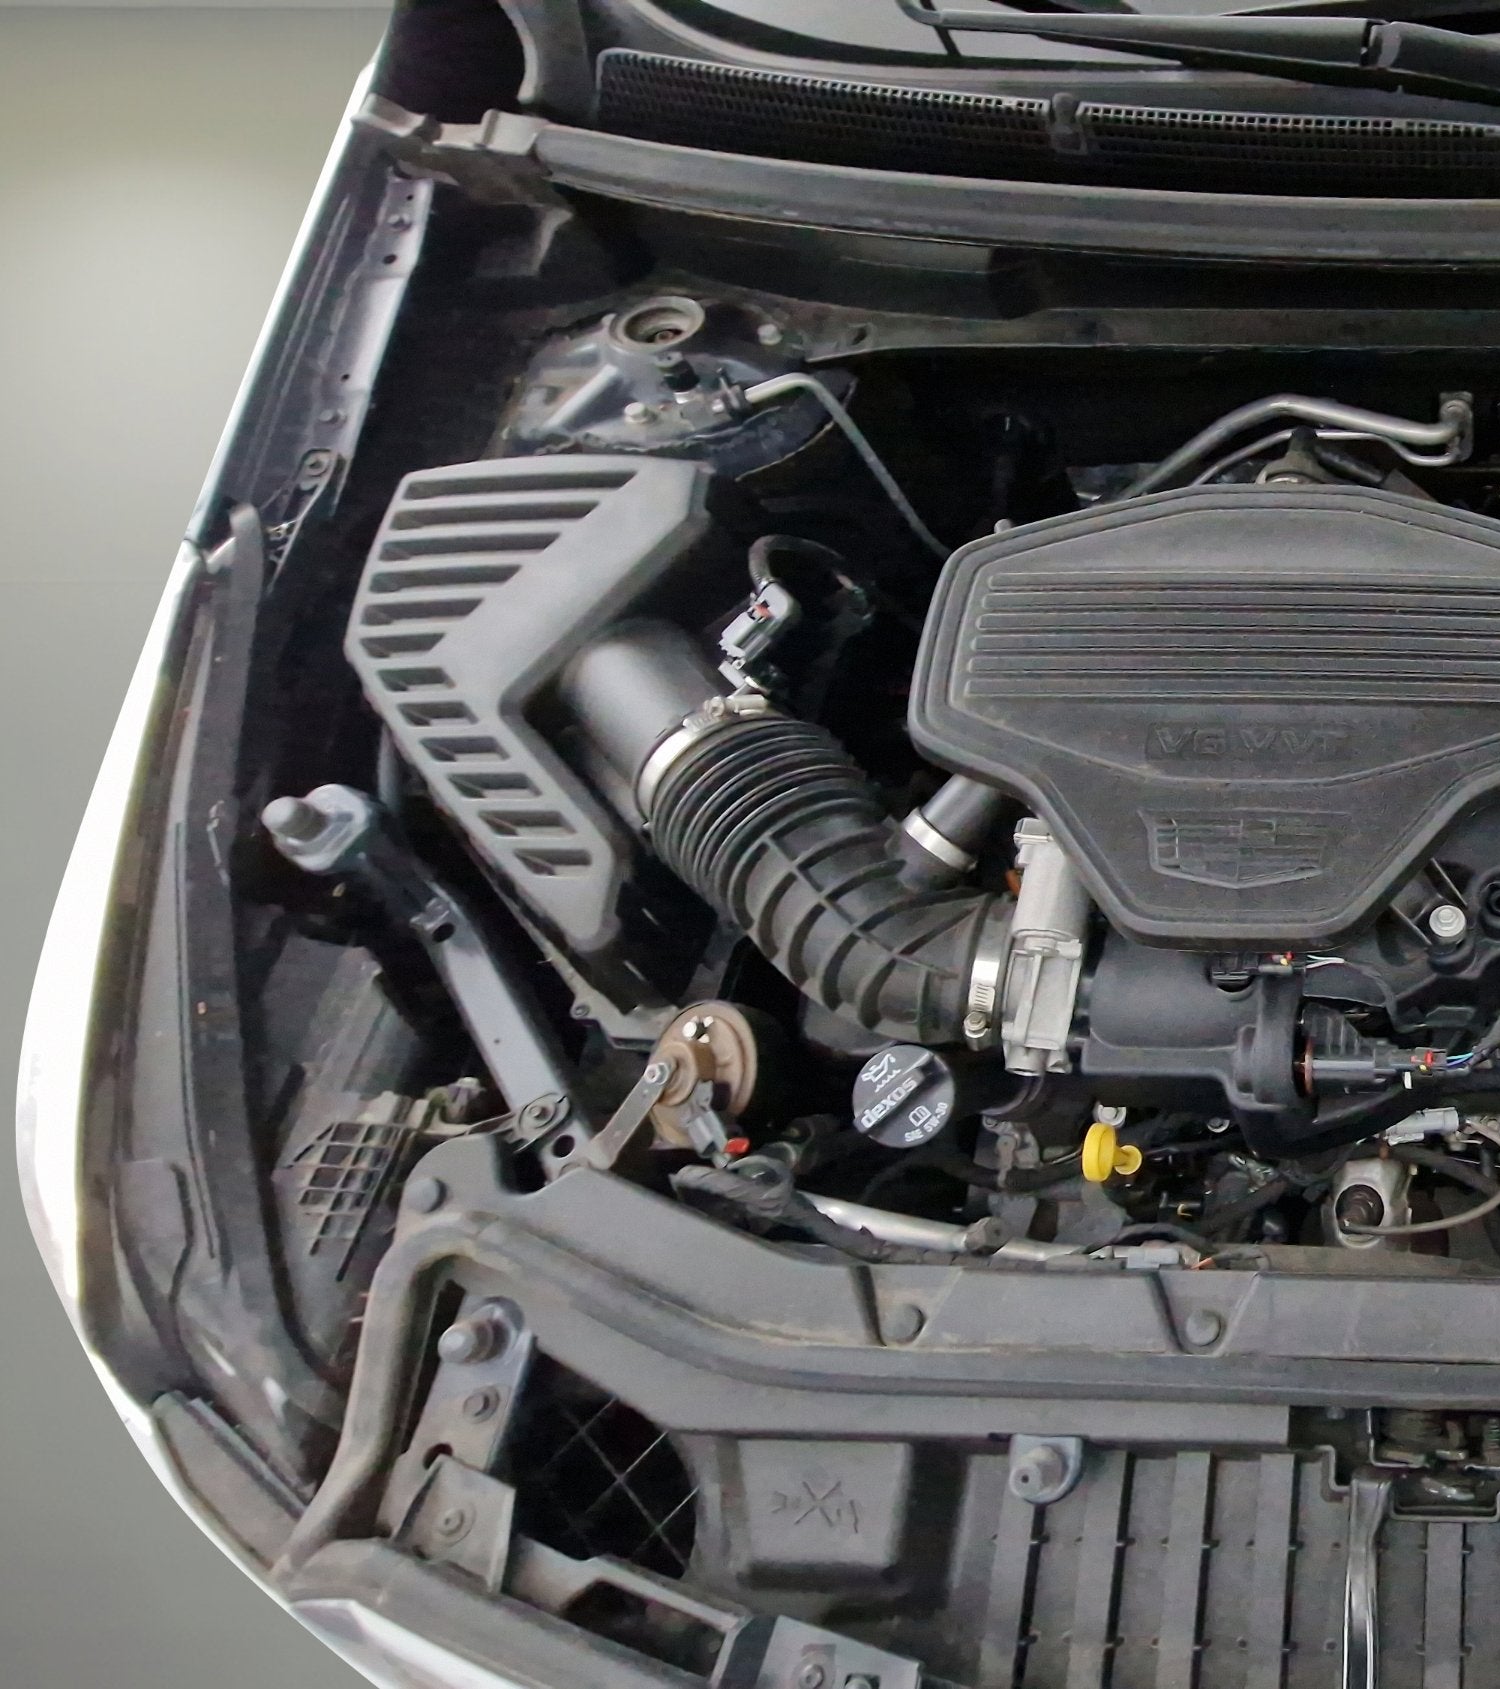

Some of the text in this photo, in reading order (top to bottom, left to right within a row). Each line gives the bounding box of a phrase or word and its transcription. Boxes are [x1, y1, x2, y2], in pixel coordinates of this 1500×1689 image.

[1154, 727, 1346, 757] V6 VVT
[861, 1076, 918, 1128] dexos
[924, 1102, 948, 1132] 5W-30
